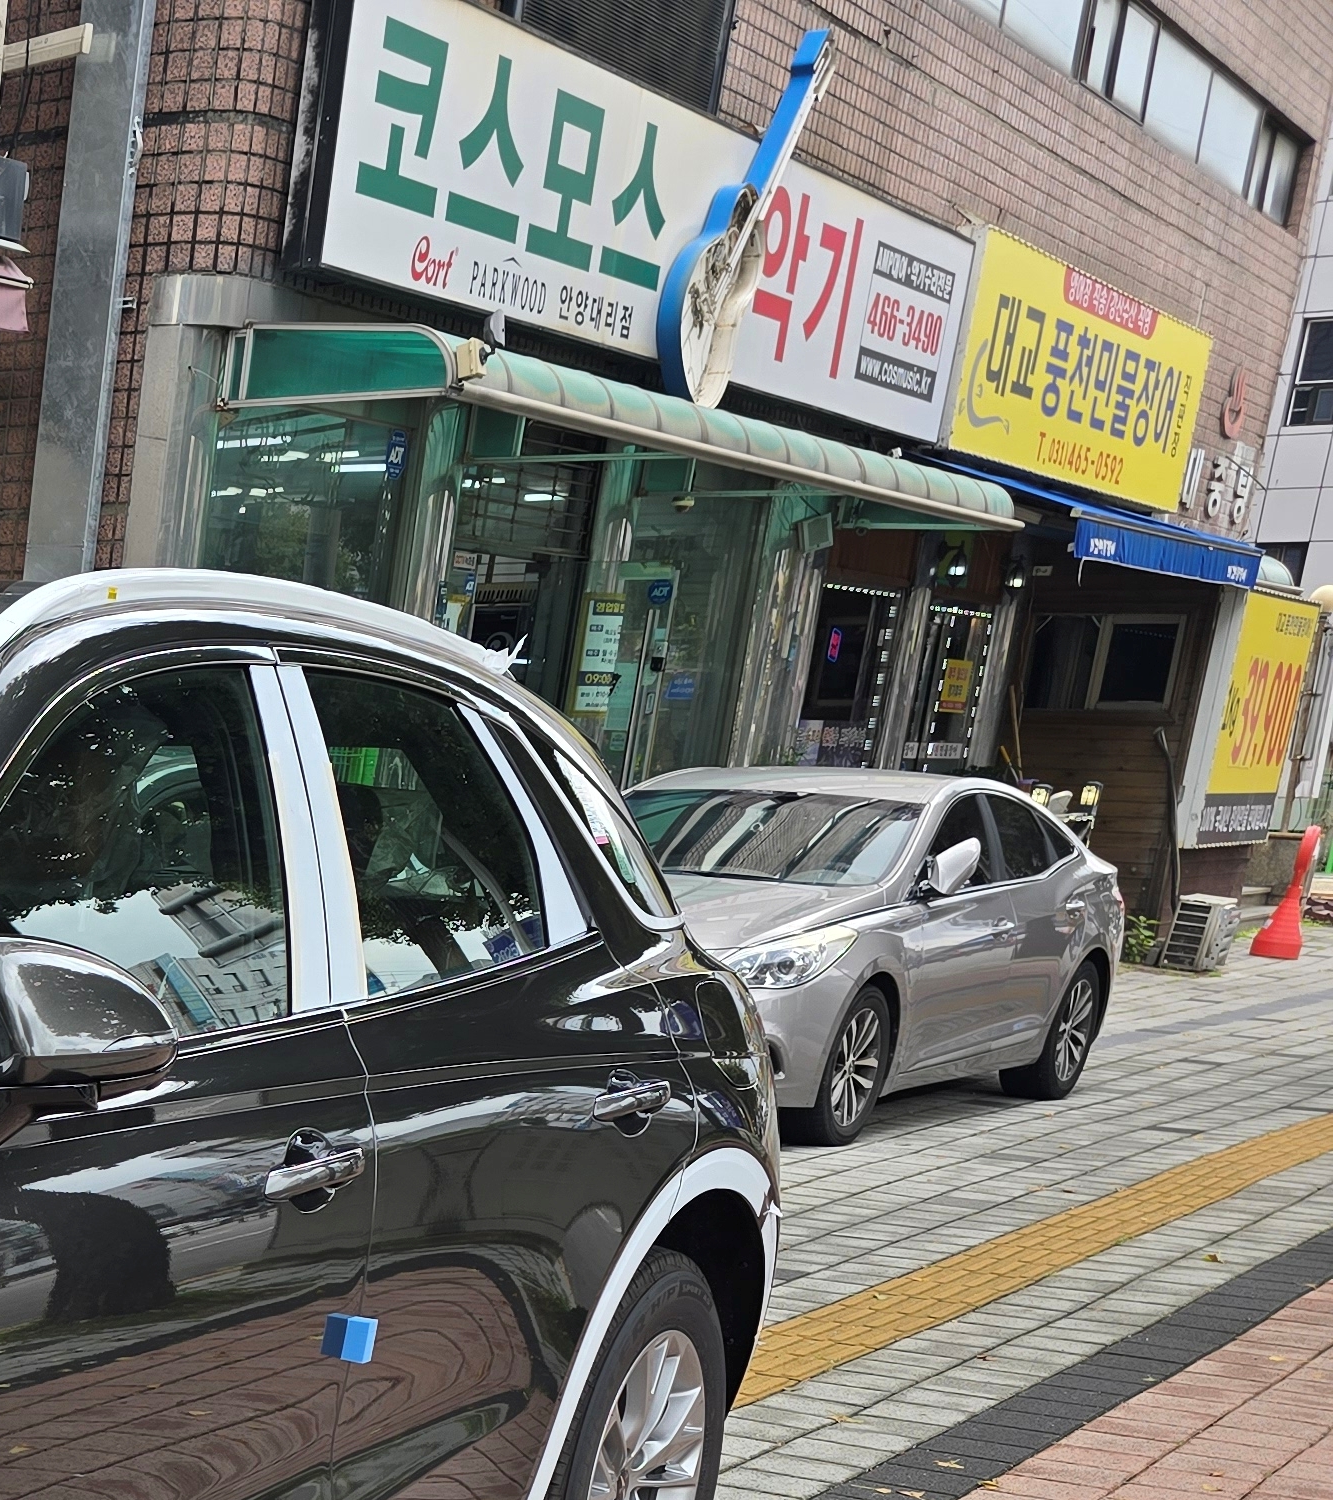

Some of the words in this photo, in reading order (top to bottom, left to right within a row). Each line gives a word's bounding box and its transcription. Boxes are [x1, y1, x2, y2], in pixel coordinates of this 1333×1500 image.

[355, 16, 666, 292] 코스모스
[752, 185, 864, 380] 악기
[410, 235, 459, 290] Cort
[469, 260, 547, 315] PARKWOOD
[559, 285, 634, 340] 안양대리점
[866, 291, 943, 357] 466-3490
[859, 354, 932, 395] www.cosmusic.kr
[985, 293, 1047, 401] 대교
[1040, 318, 1182, 455] 풍천민물장어
[387, 446, 404, 465] ADT
[651, 586, 671, 598] ADT
[1231, 656, 1304, 769] 39,900
